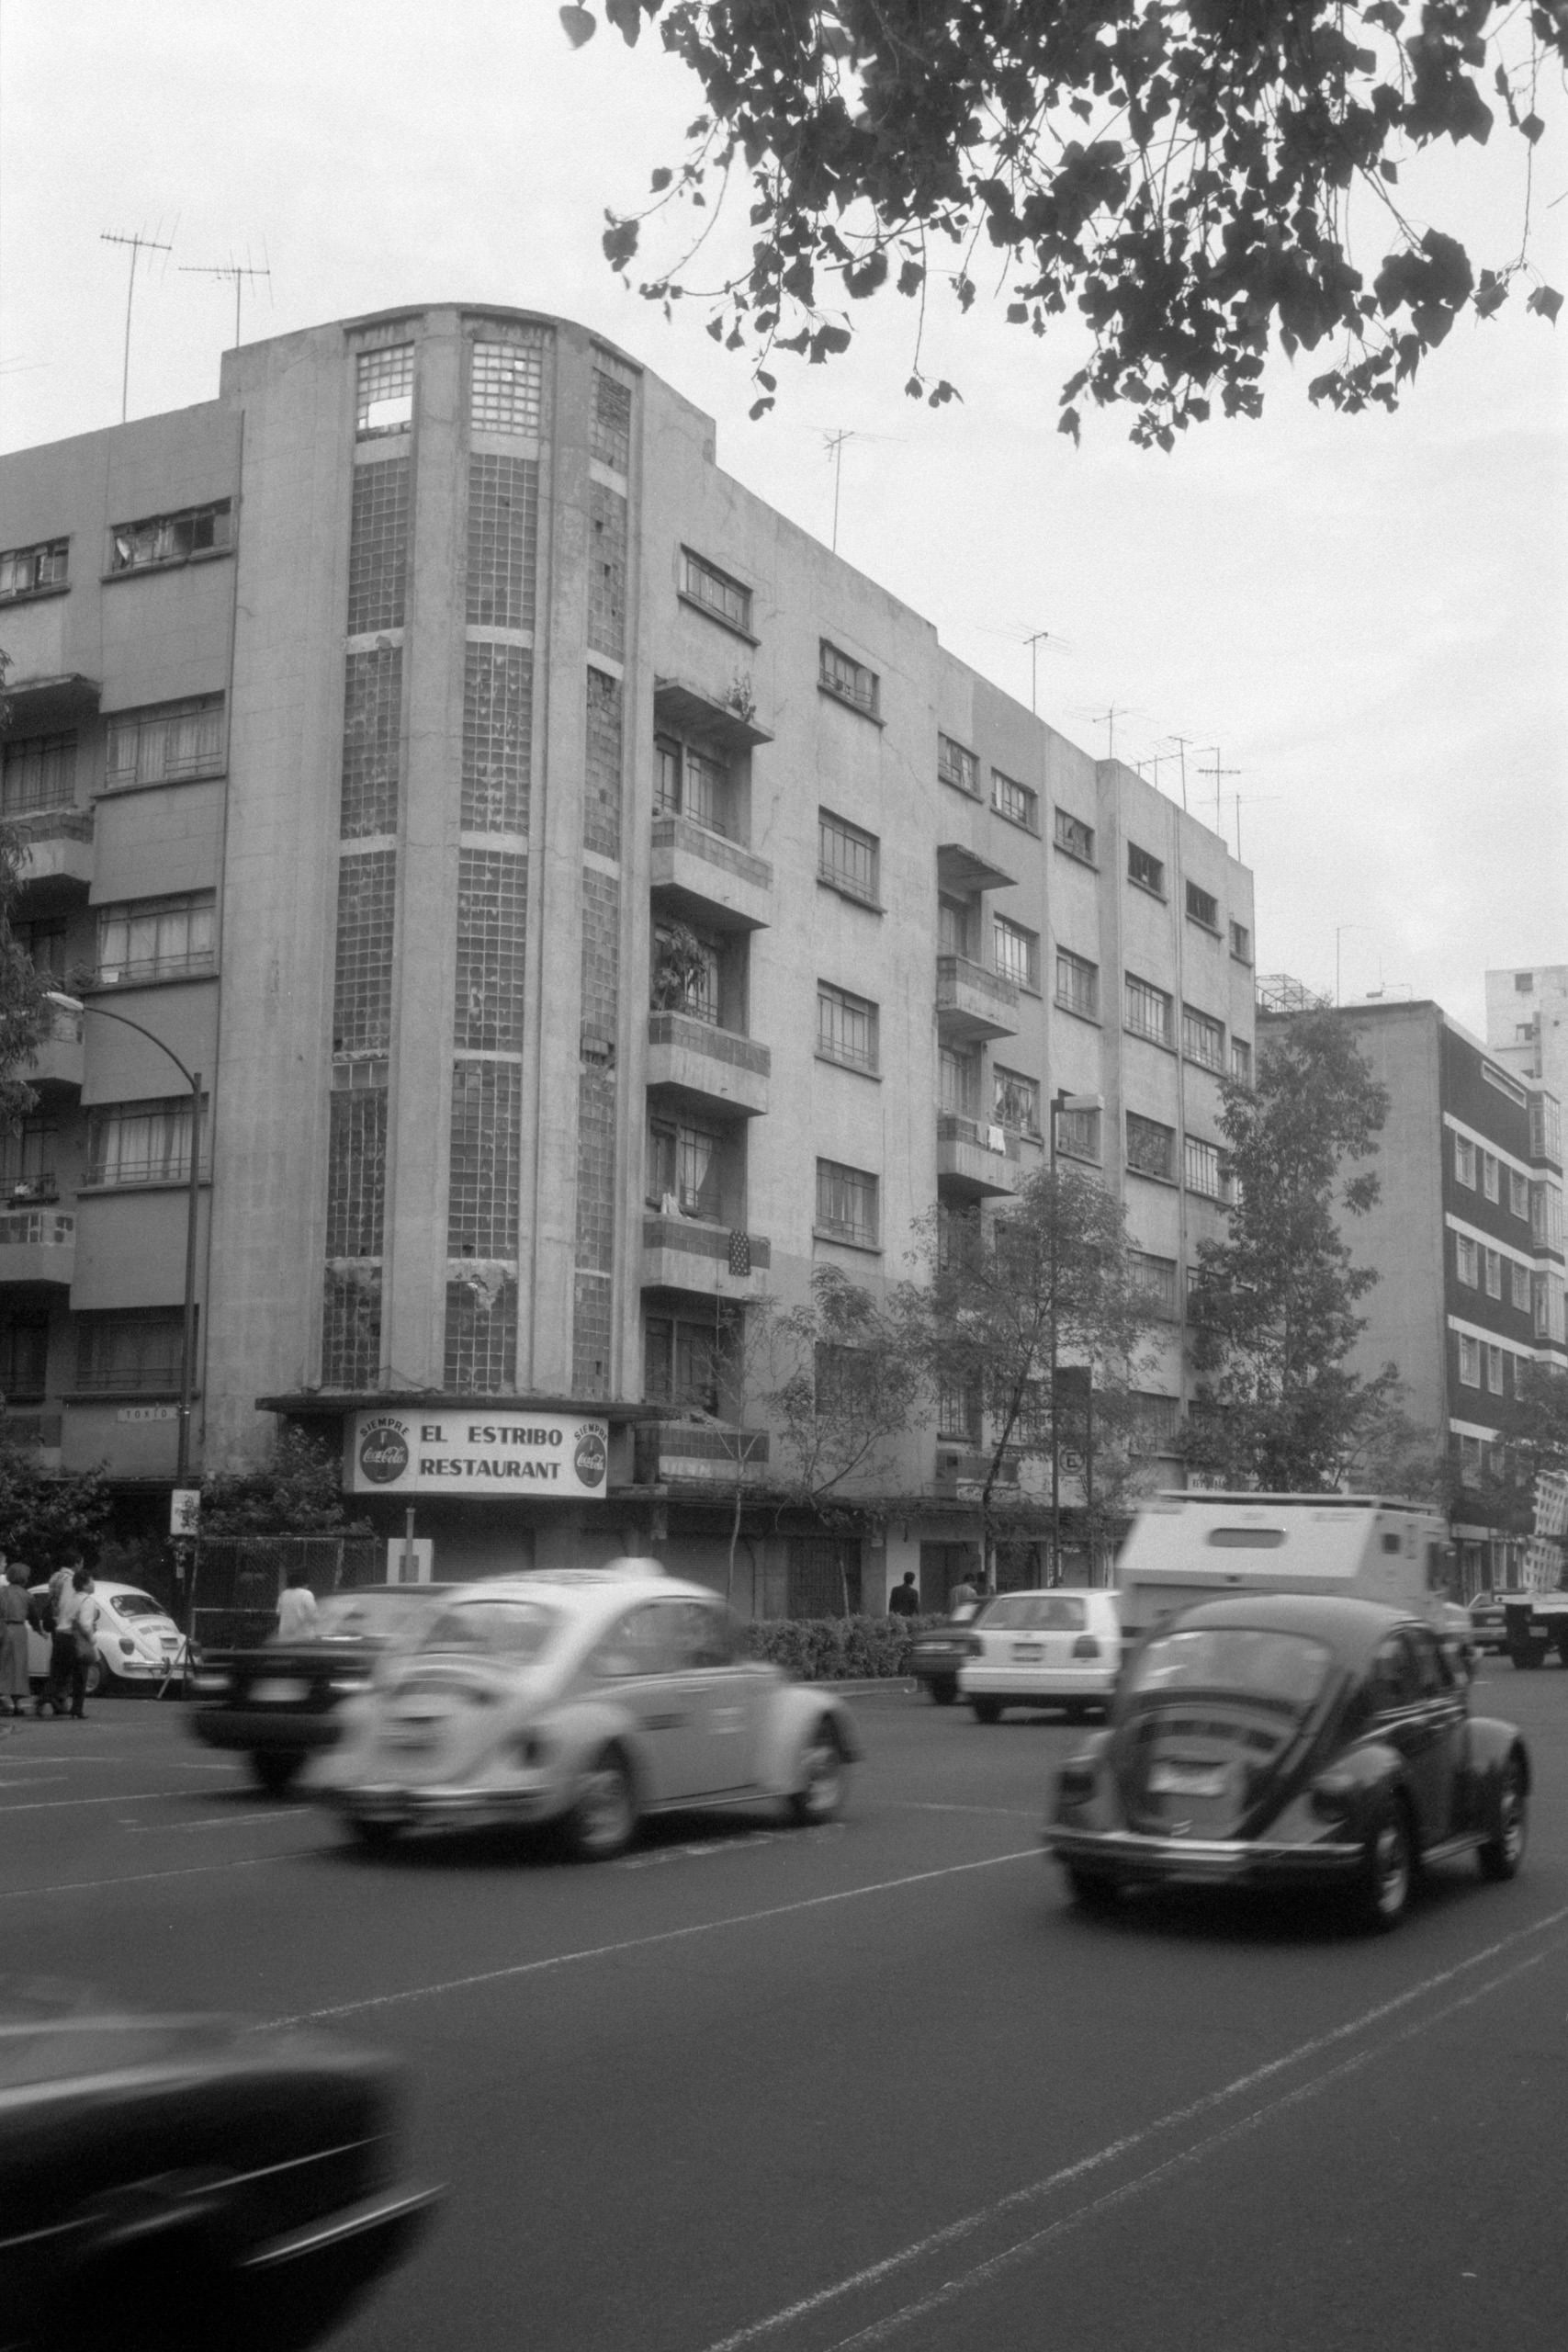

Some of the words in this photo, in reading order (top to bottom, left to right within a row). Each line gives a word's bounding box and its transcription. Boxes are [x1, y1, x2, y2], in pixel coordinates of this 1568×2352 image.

[360, 1418, 410, 1437] SIEMPRE
[421, 1425, 447, 1442] EL
[468, 1426, 563, 1446] ESTRIBO
[419, 1458, 561, 1479] RESTAURANT
